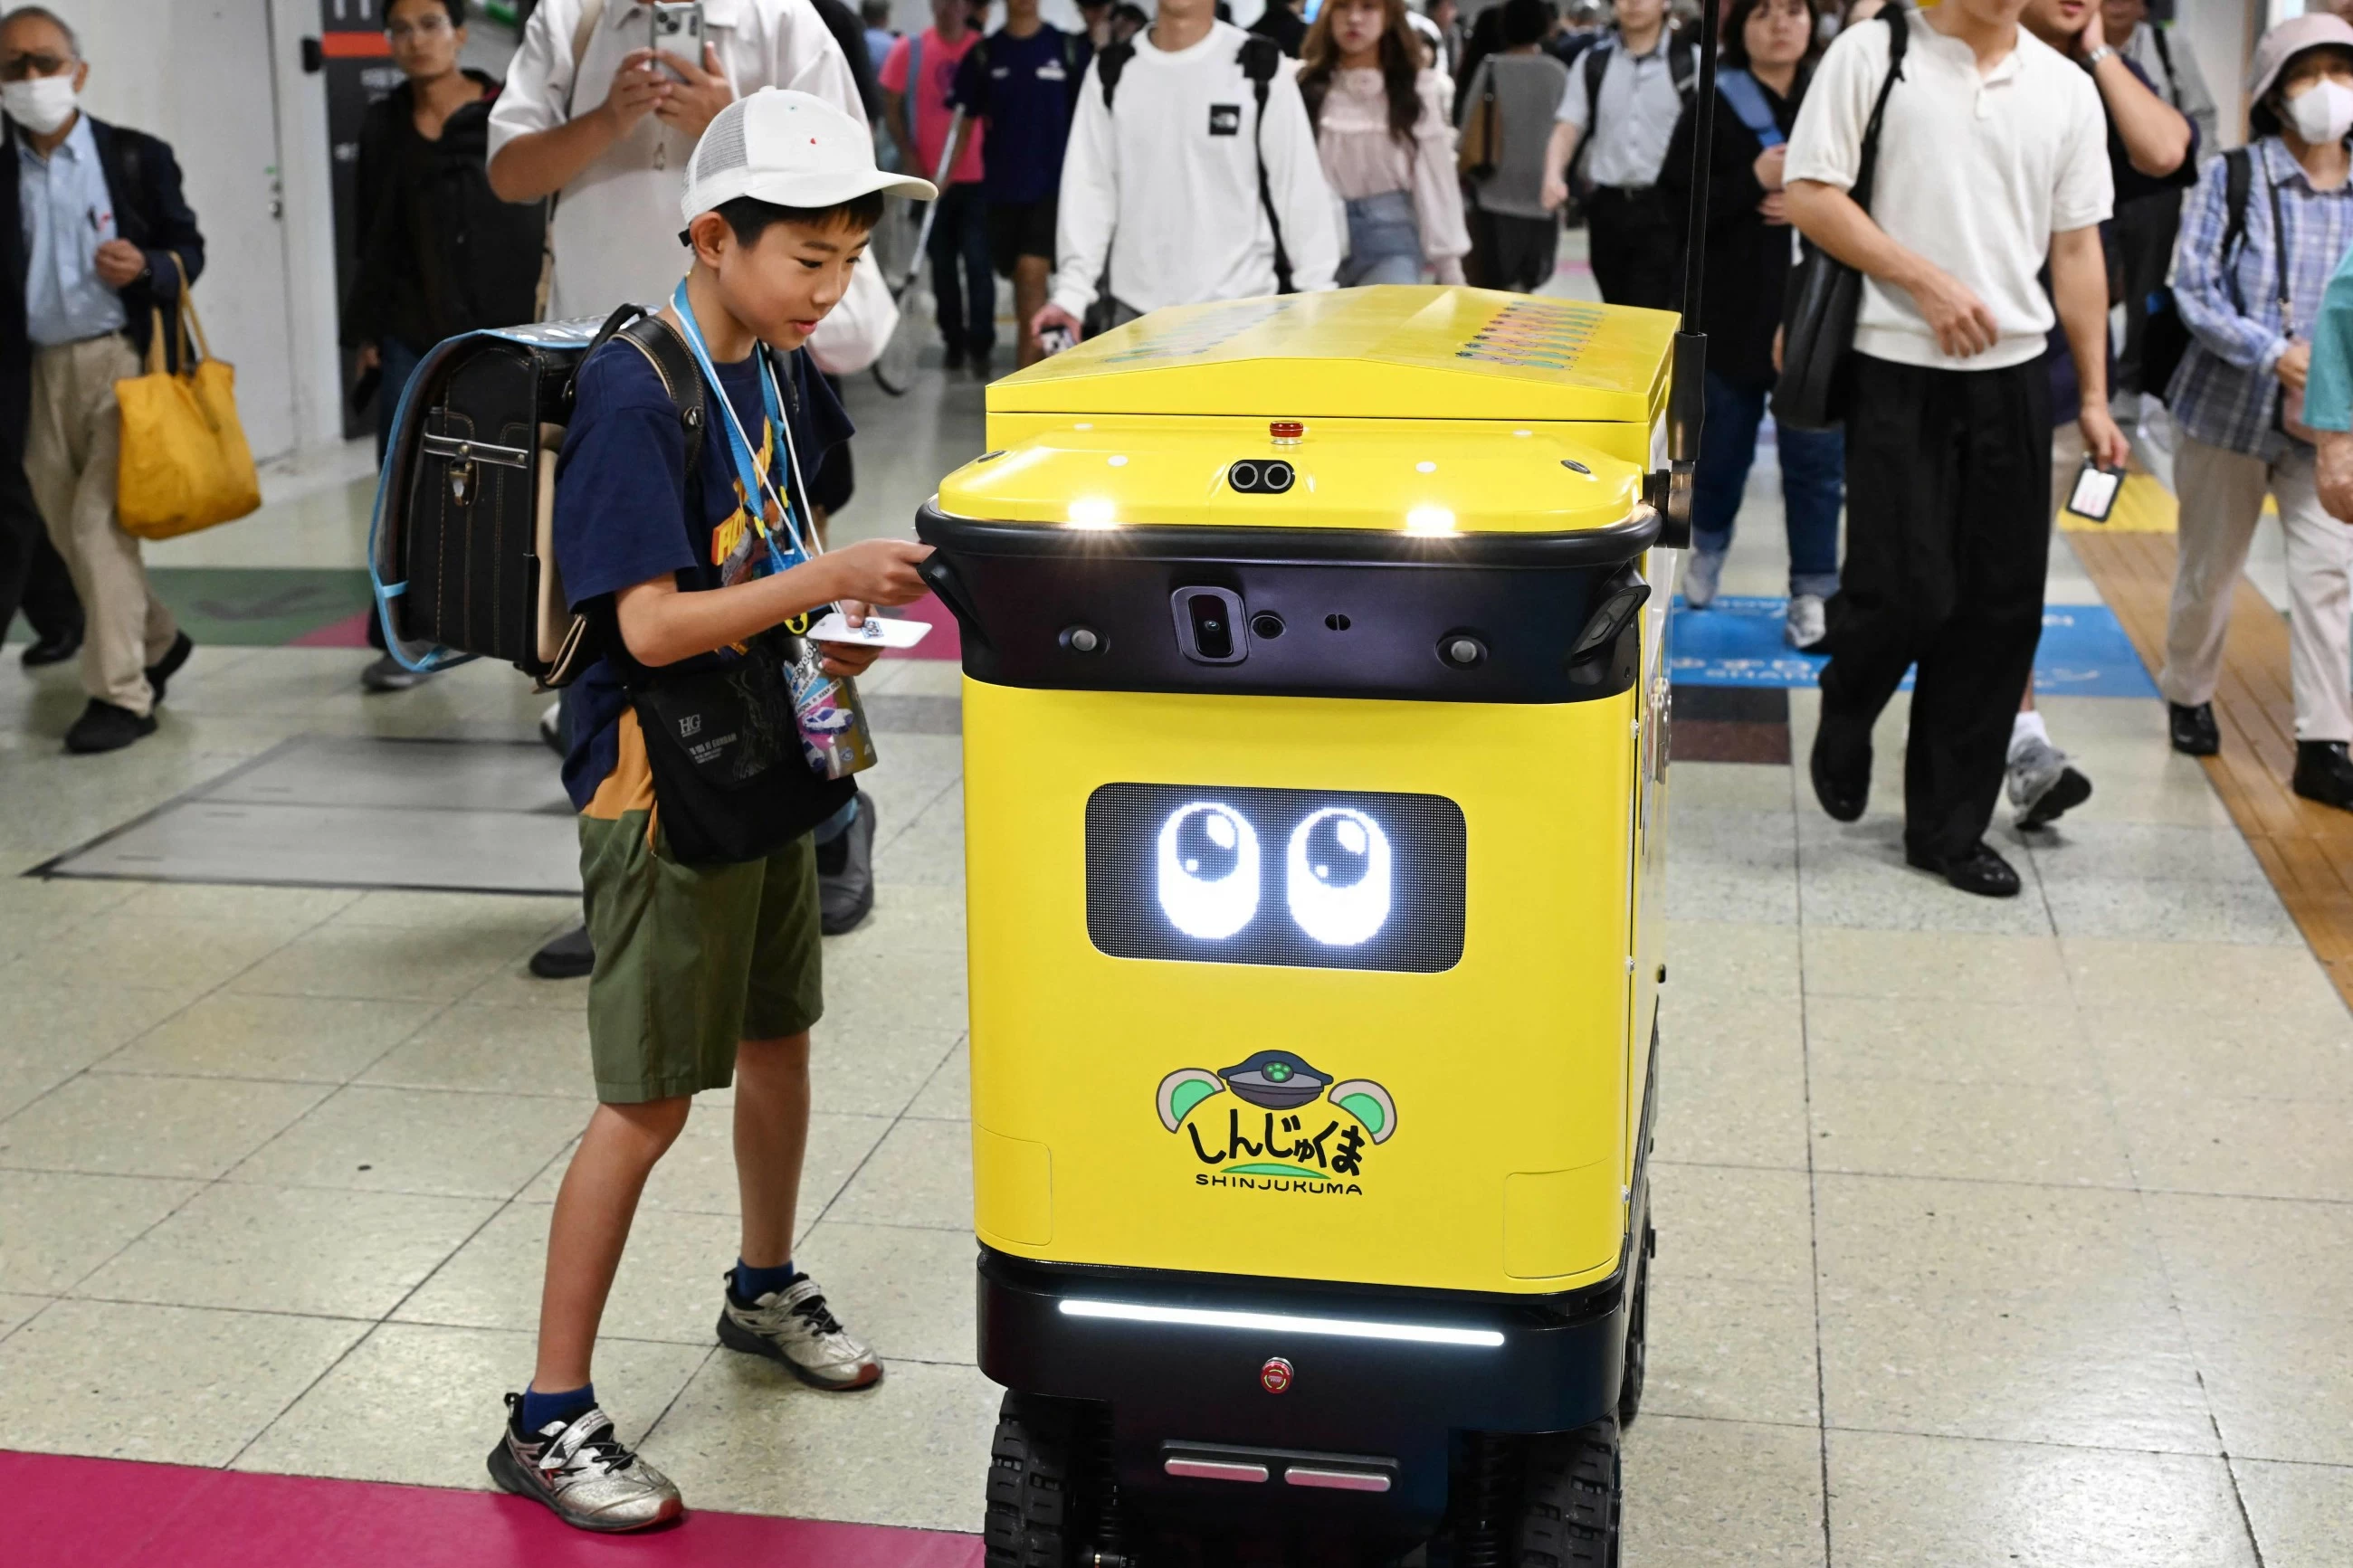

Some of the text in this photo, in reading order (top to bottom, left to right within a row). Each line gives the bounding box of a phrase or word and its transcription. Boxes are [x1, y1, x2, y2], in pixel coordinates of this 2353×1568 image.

[678, 713, 701, 734] HG
[1187, 1108, 1366, 1176] しんじゅくま
[1196, 1174, 1363, 1195] SHINJUKUMA
